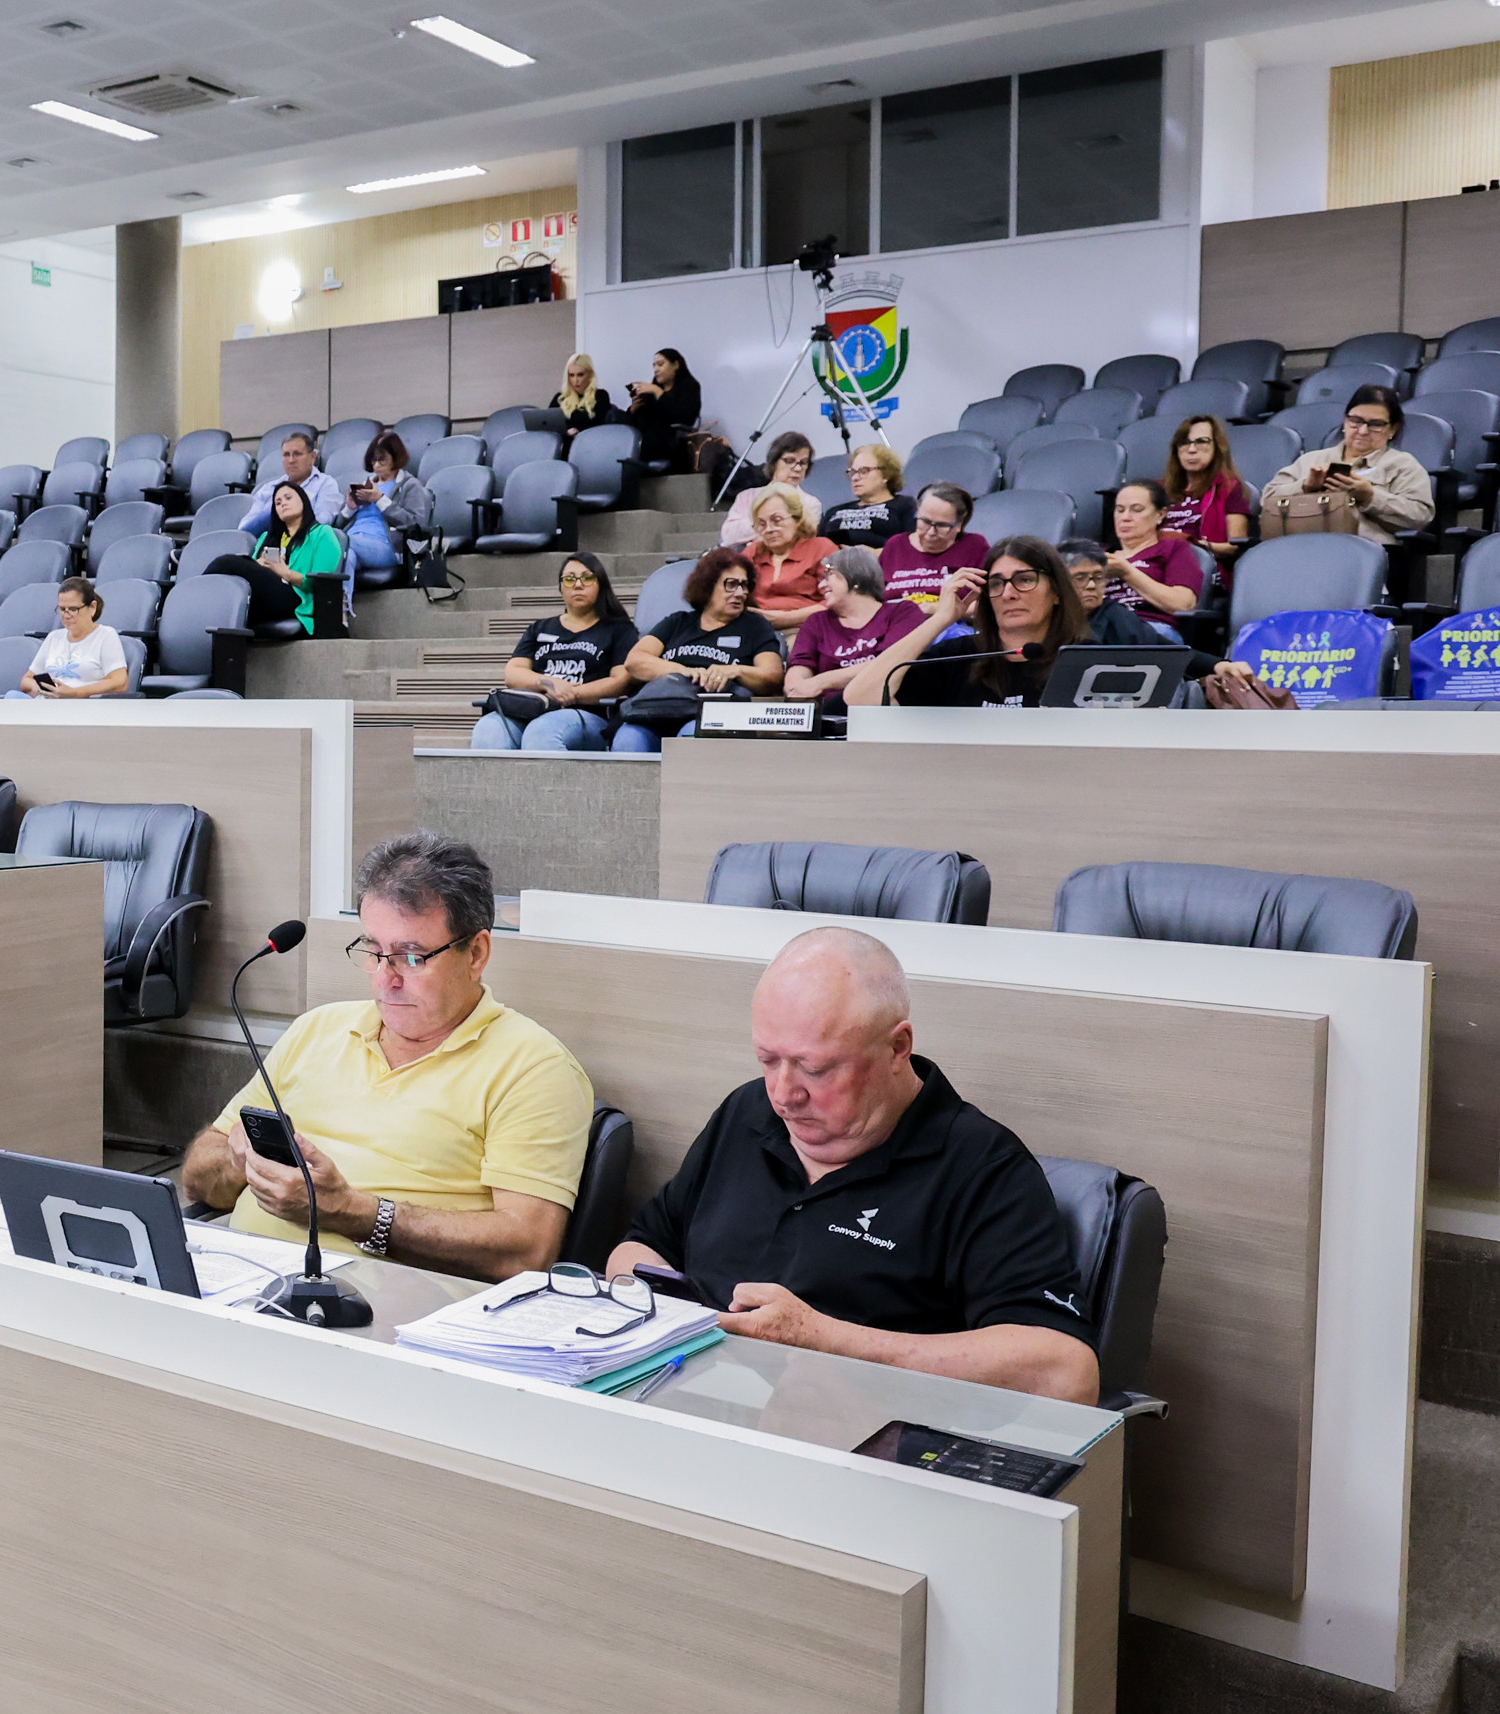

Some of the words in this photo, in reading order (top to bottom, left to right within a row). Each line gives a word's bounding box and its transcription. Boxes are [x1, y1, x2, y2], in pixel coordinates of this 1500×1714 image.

[1441, 629, 1500, 642] PRIORI
[552, 641, 597, 656] PROFESSORA
[678, 645, 730, 664] PROFESSORA
[544, 659, 586, 675] AINDA
[765, 707, 805, 715] PROFESSORA
[748, 717, 775, 725] LUCIANA
[775, 717, 804, 726] MARTINS
[828, 1223, 862, 1240] Convoy
[862, 1232, 897, 1250] Supply
